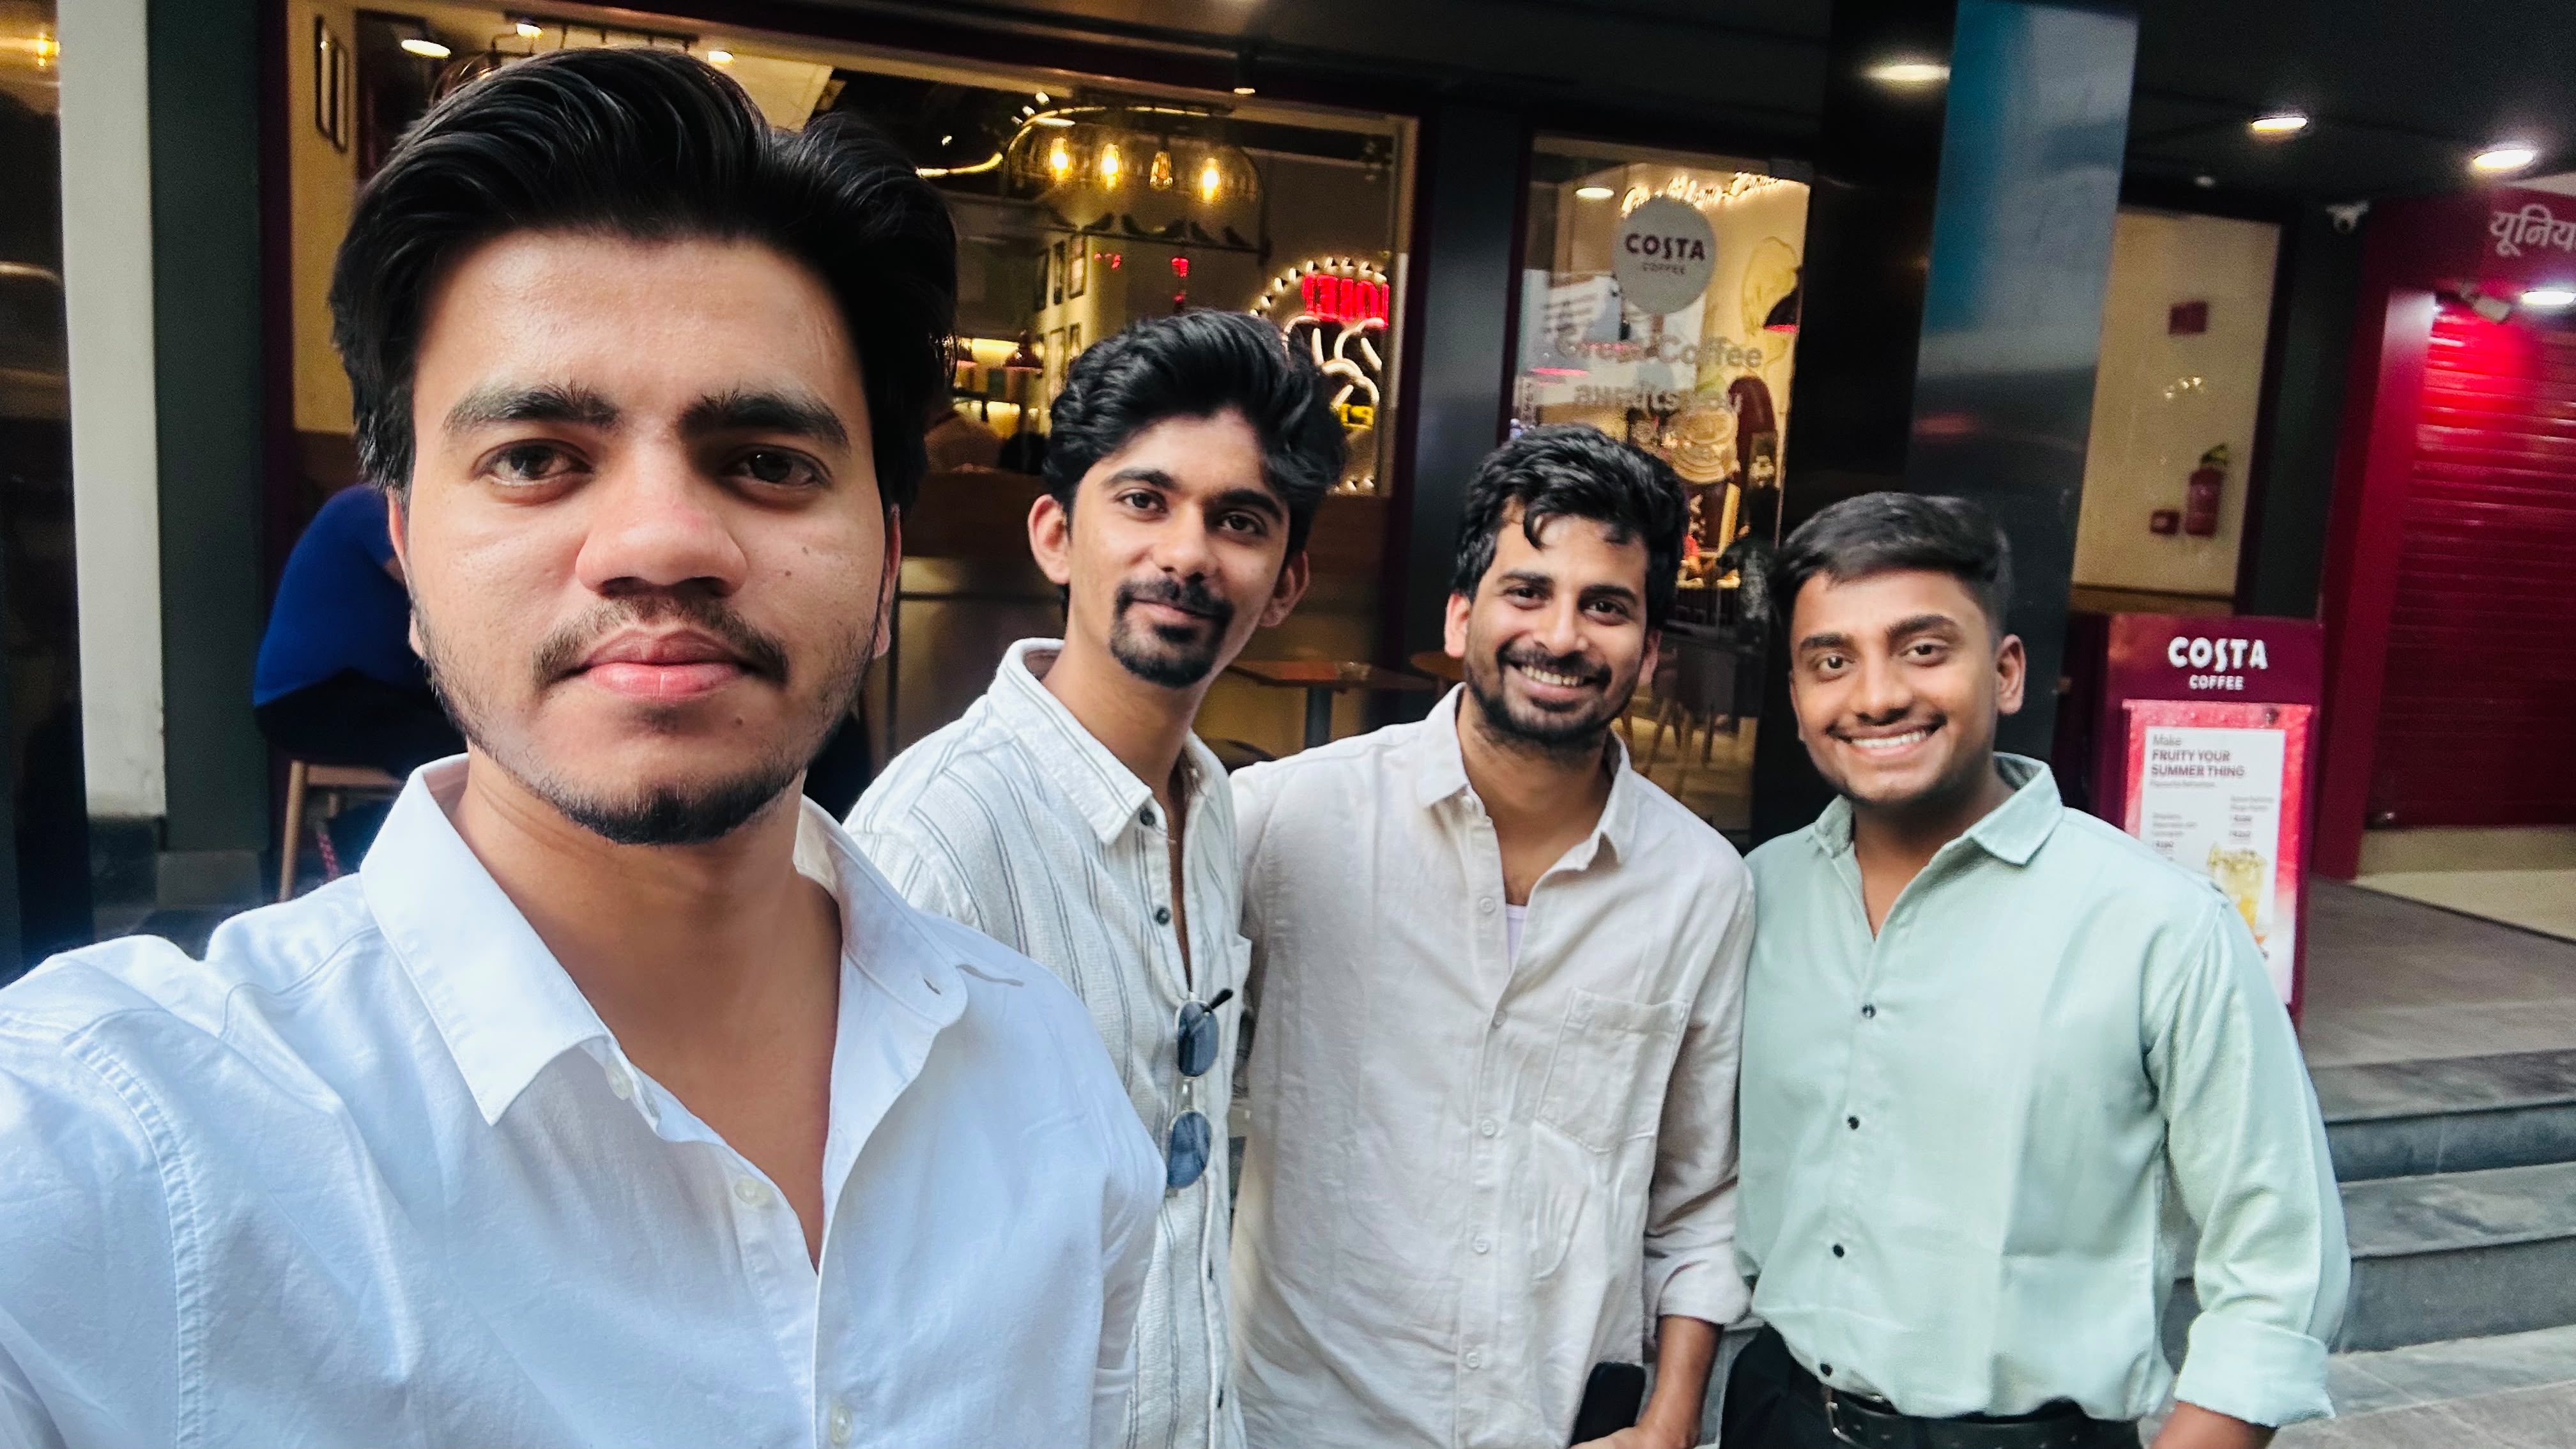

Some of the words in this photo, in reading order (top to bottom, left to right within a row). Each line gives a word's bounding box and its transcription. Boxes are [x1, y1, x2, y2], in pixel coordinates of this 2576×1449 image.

[2490, 204, 2576, 256] यूनिय
[1625, 233, 1705, 260] COSTA
[1642, 262, 1686, 275] COFFEE
[2168, 636, 2268, 672] COSTA
[2189, 675, 2244, 690] COFFEE
[2152, 734, 2182, 746] Make
[2152, 749, 2195, 762] FRUITY
[2198, 749, 2230, 762] YOUR
[2151, 764, 2204, 777] SUMMER
[2208, 765, 2245, 778] THING
